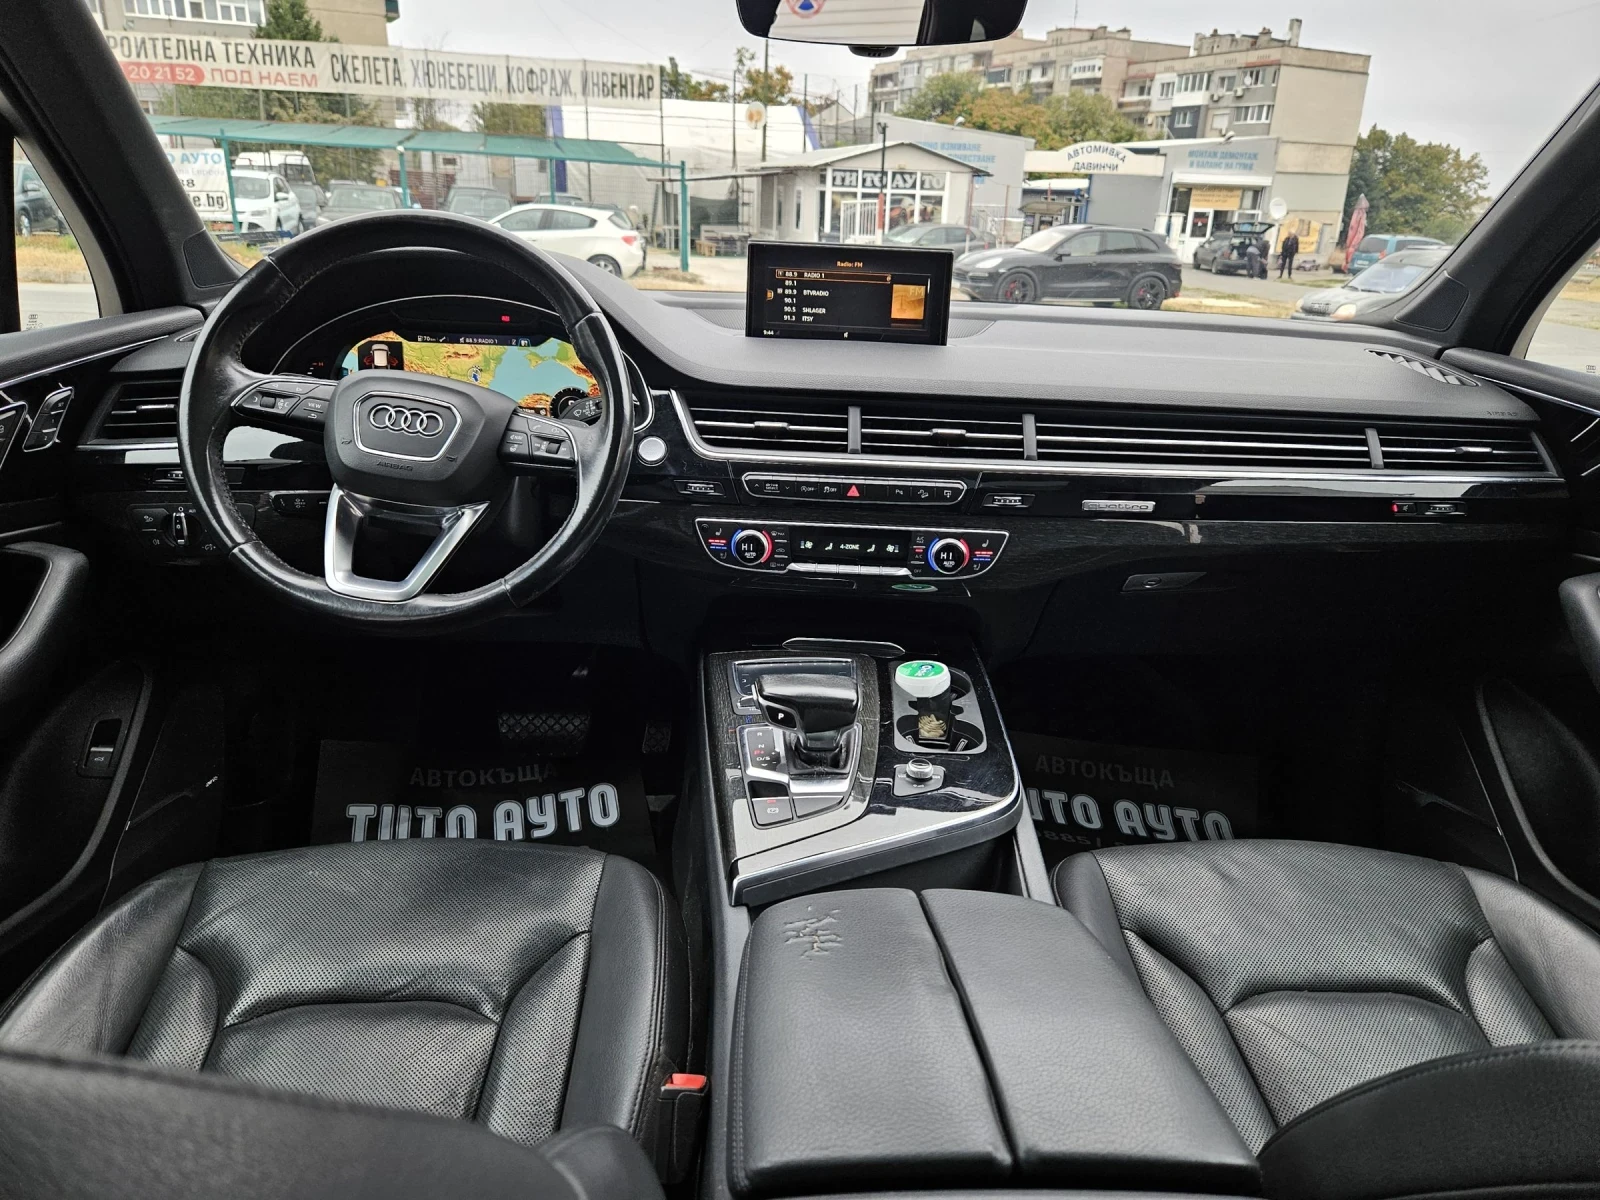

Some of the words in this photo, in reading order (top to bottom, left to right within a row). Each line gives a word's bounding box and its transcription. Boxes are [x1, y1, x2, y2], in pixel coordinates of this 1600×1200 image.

[221, 42, 316, 69] ТЕХНИКА
[128, 65, 150, 80] 20
[154, 67, 172, 80] 21
[175, 68, 196, 81] 52
[211, 68, 253, 85] ПОД
[259, 71, 318, 88] НАЕМ
[580, 70, 654, 100] ИНВЕНТАР
[180, 152, 222, 165] АУТО
[1066, 144, 1127, 163] АВТОМИВКА
[1072, 161, 1119, 172] ДАВИНЧИ
[909, 286, 924, 297] FM
[778, 712, 785, 720] P
[1035, 754, 1176, 791] АВТОКЪЩА
[493, 782, 620, 842] АУТО
[1113, 799, 1235, 842] АУТО
